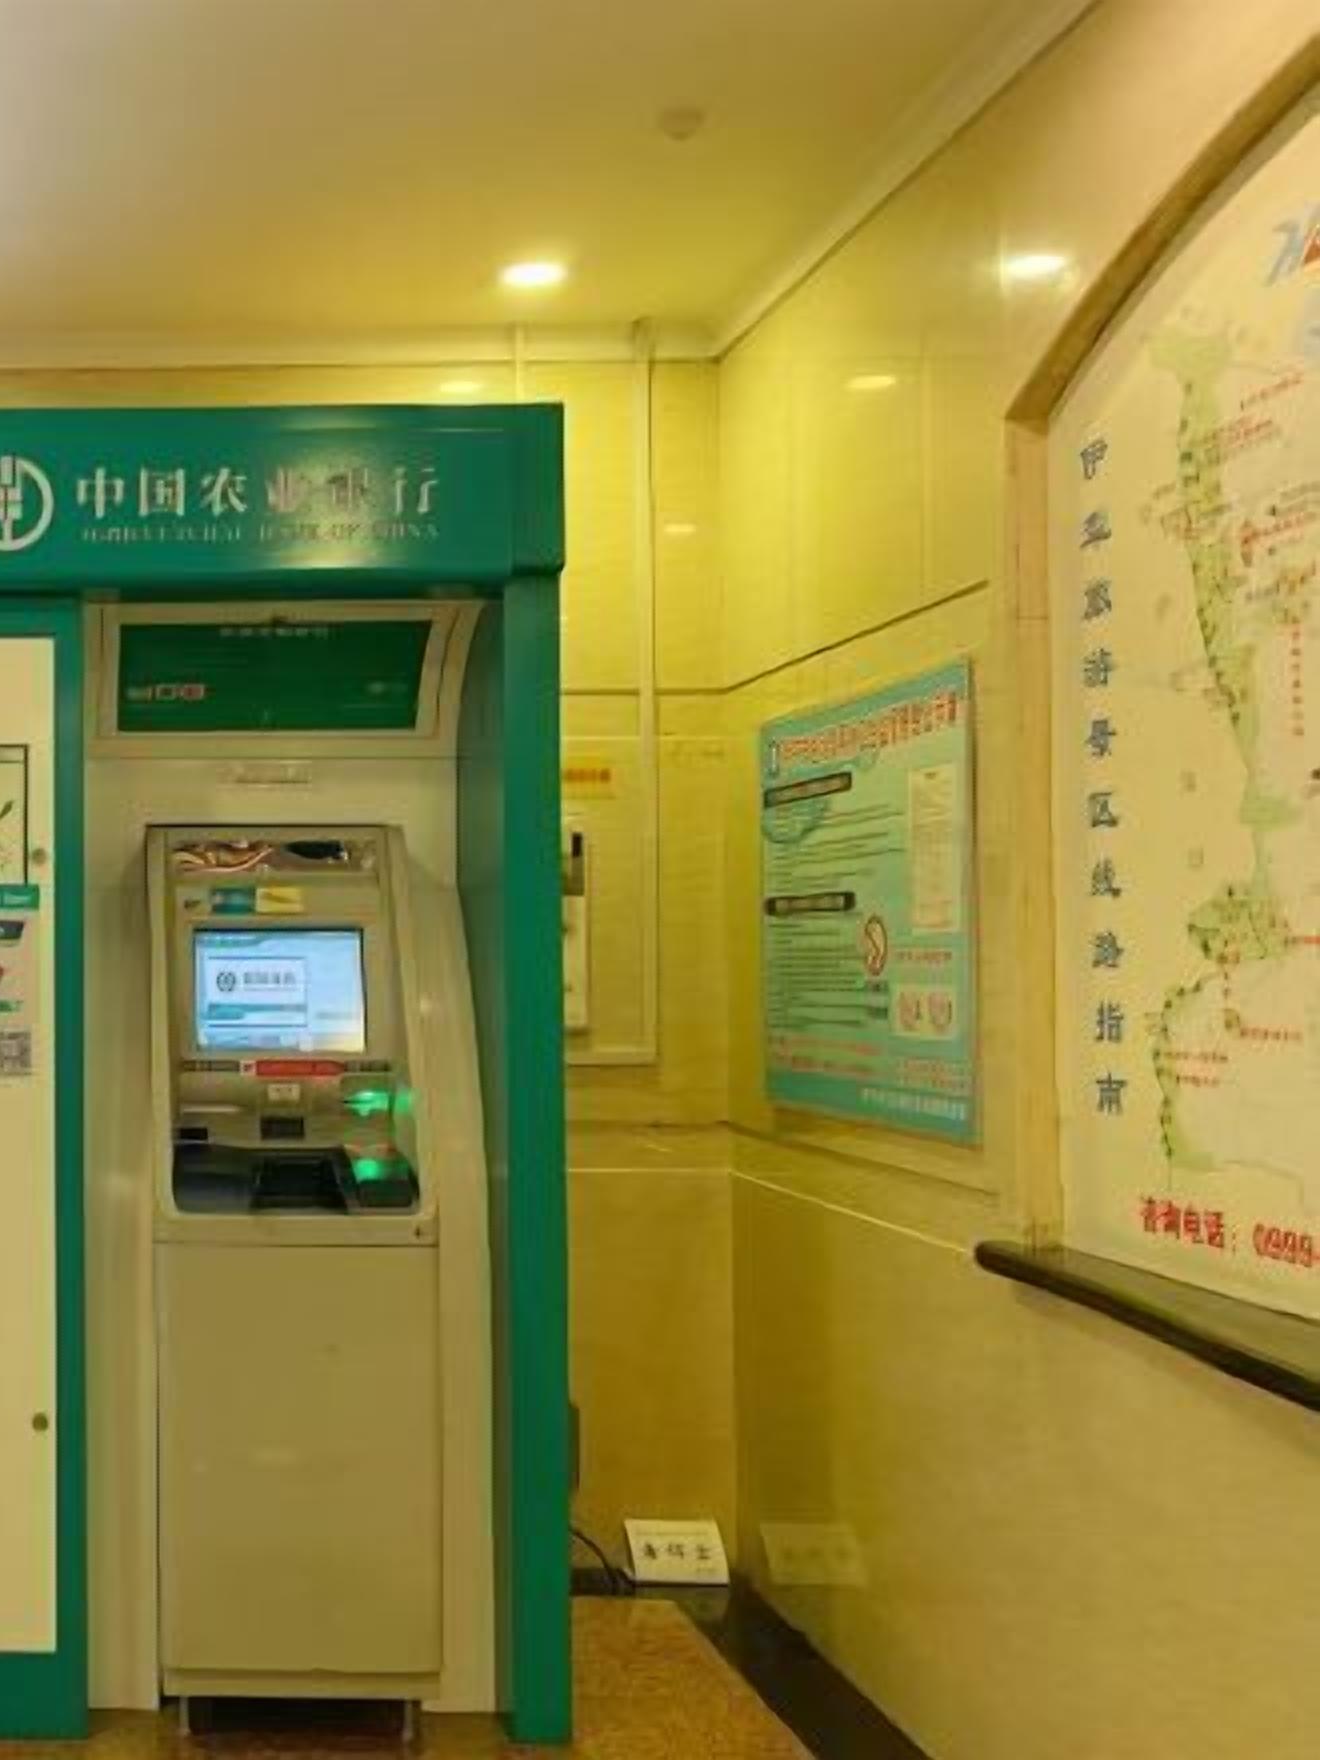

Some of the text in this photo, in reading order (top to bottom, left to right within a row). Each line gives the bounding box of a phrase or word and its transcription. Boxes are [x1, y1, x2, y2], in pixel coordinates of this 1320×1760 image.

[76, 466, 439, 518] 中国农业银行
